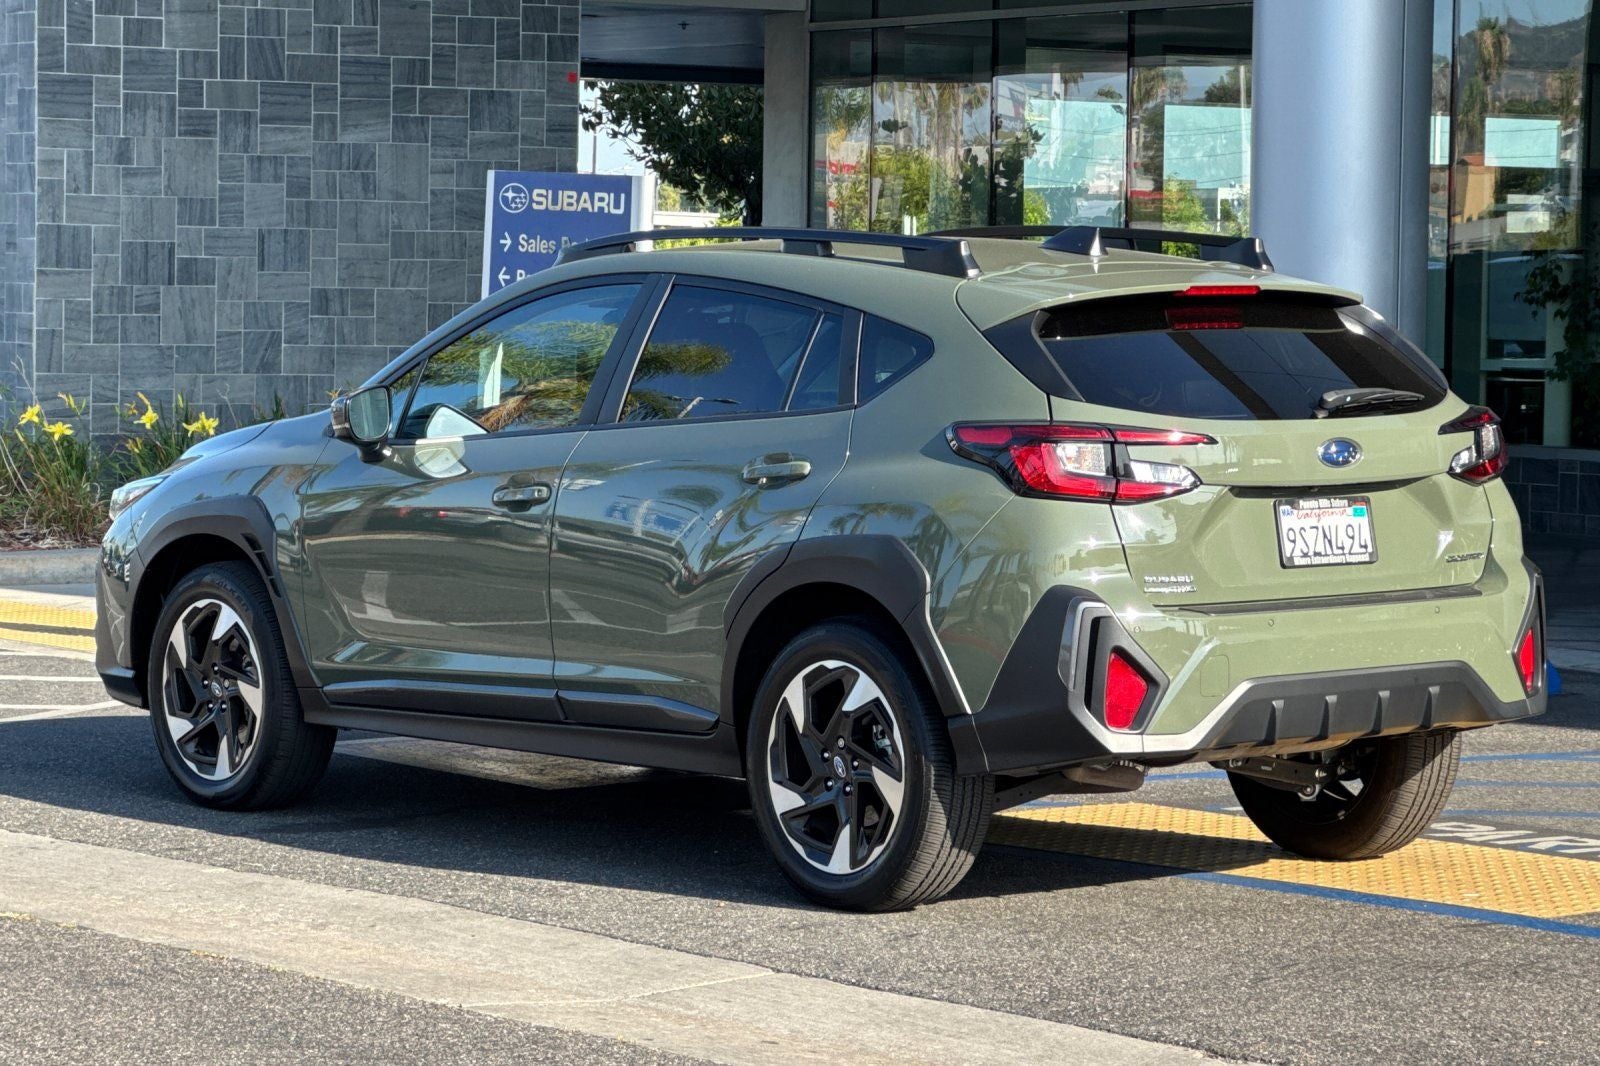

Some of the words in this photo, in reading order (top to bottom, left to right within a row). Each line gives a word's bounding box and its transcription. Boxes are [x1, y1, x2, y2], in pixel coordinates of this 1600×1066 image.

[531, 188, 625, 215] SUBARU
[518, 233, 557, 254] Sales
[1286, 523, 1369, 558] 9SZN494
